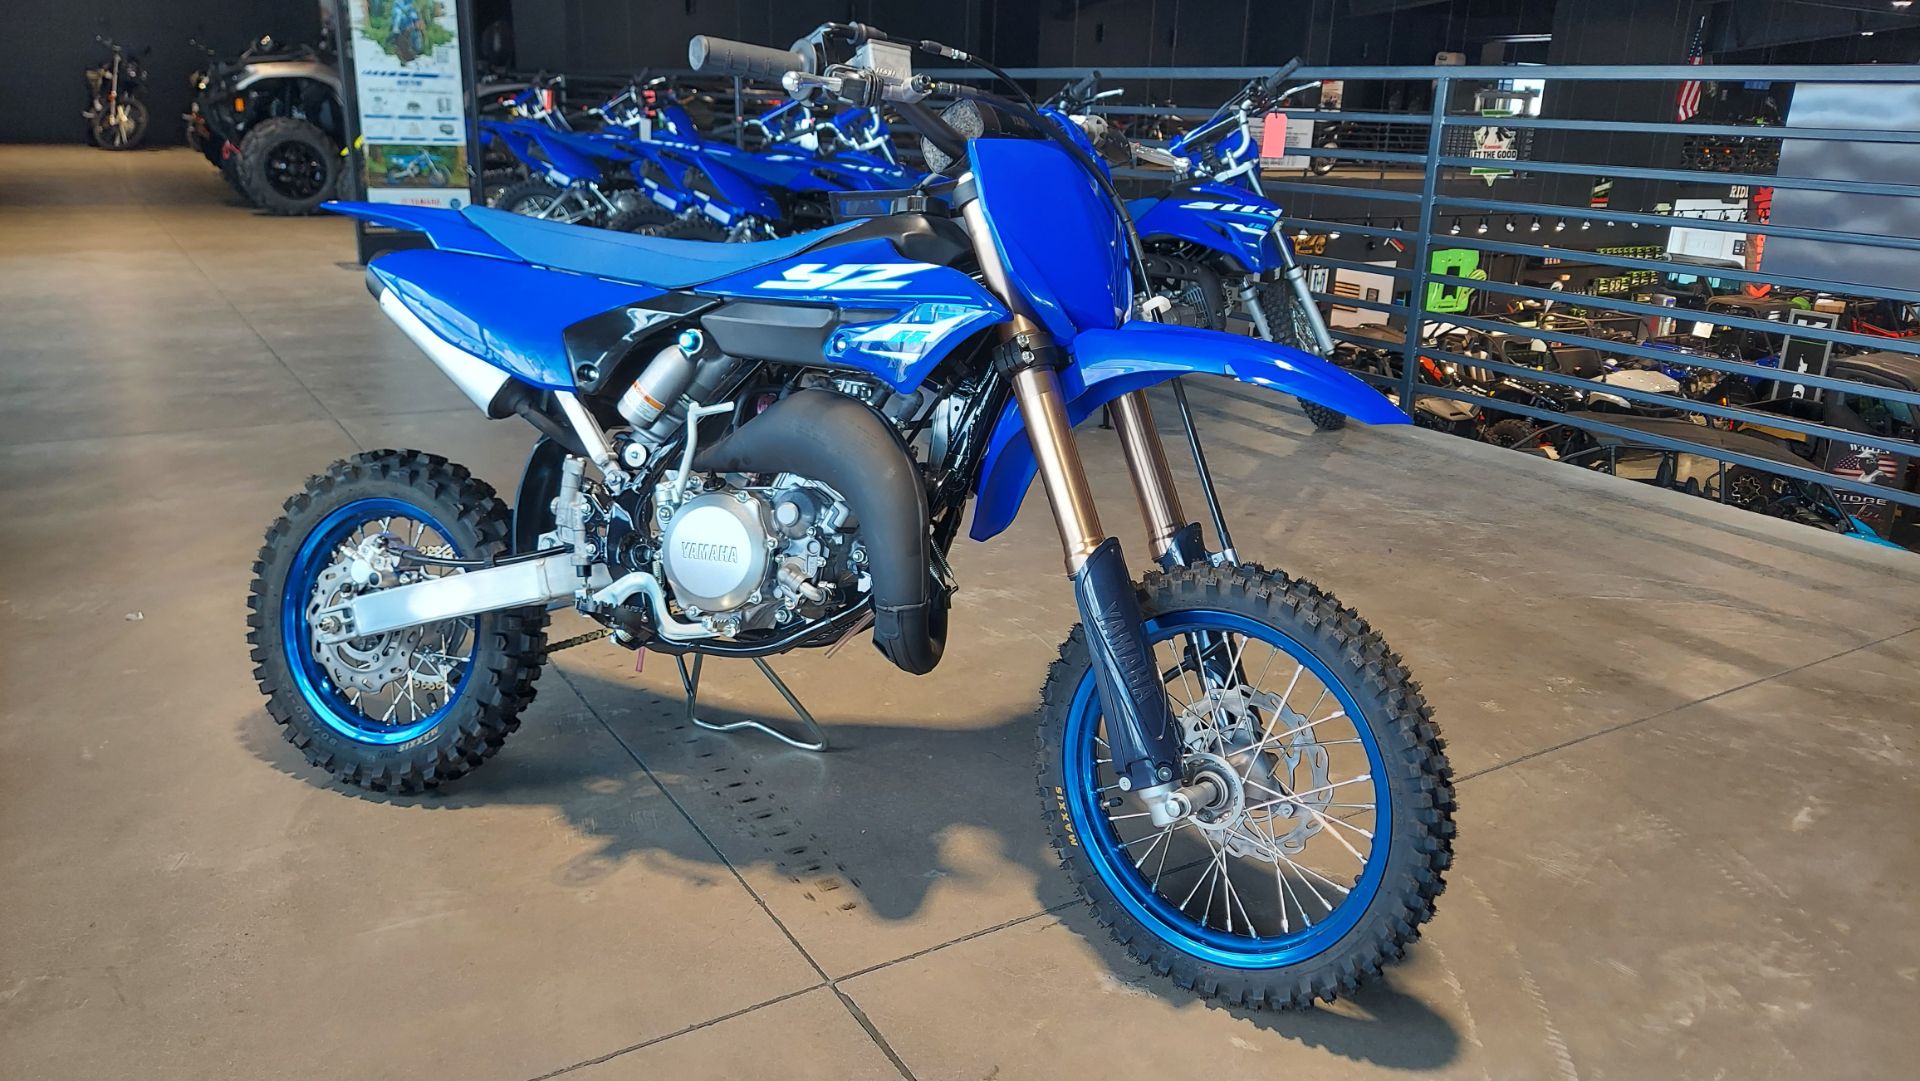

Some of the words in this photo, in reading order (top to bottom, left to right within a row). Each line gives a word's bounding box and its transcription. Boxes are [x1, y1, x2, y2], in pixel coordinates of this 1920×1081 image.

[1497, 151, 1517, 159] GOOD
[681, 541, 738, 563] YAMAHA
[1097, 601, 1152, 704] YAMAHA
[1055, 786, 1079, 847] MAXXIS
